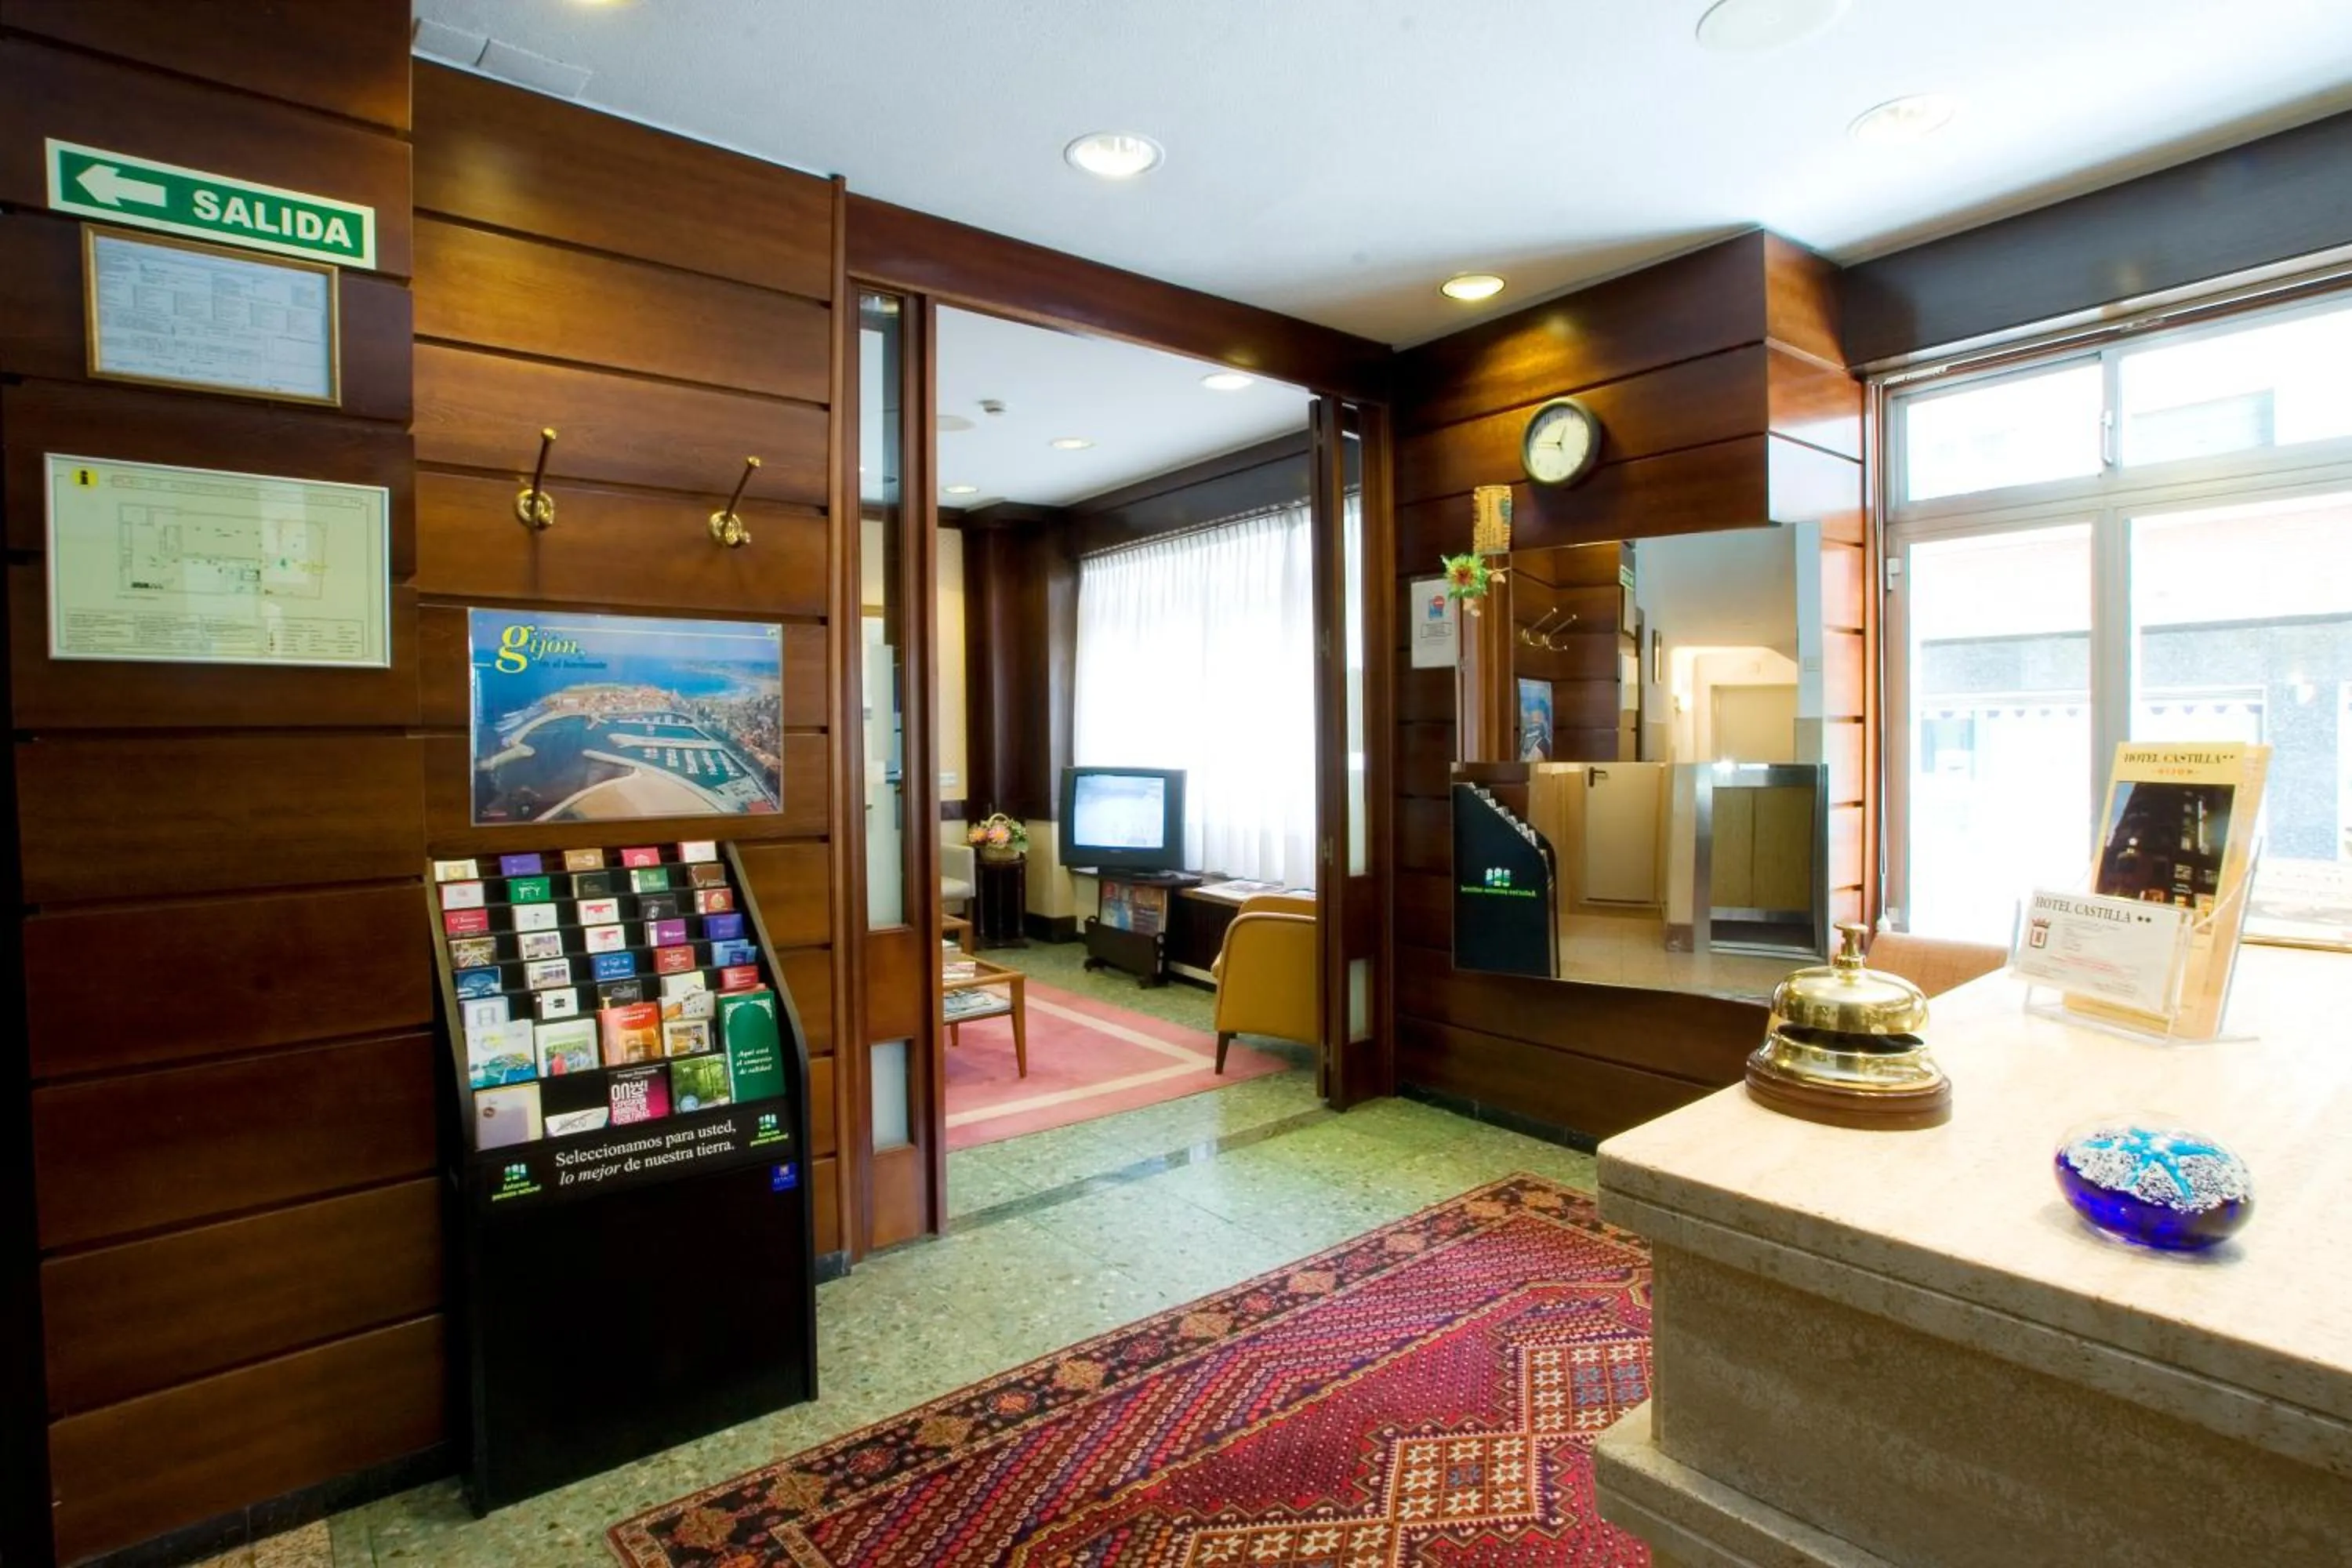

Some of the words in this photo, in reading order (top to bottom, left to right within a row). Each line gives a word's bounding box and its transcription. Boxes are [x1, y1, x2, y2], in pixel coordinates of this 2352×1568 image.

[192, 188, 353, 249] SALIDA
[2123, 753, 2158, 764] HOTEL
[2163, 753, 2222, 764] CASTILLA
[2034, 896, 2071, 913] HOTEL
[2074, 902, 2132, 924] CASTILLA
[555, 1136, 662, 1167] Seleccionamos
[666, 1129, 695, 1149] para
[698, 1119, 737, 1138] usted,
[559, 1171, 575, 1186] lo
[578, 1163, 622, 1181] mejor
[623, 1158, 641, 1173] de
[644, 1148, 694, 1168] nuestra
[696, 1140, 735, 1157] tierra.
